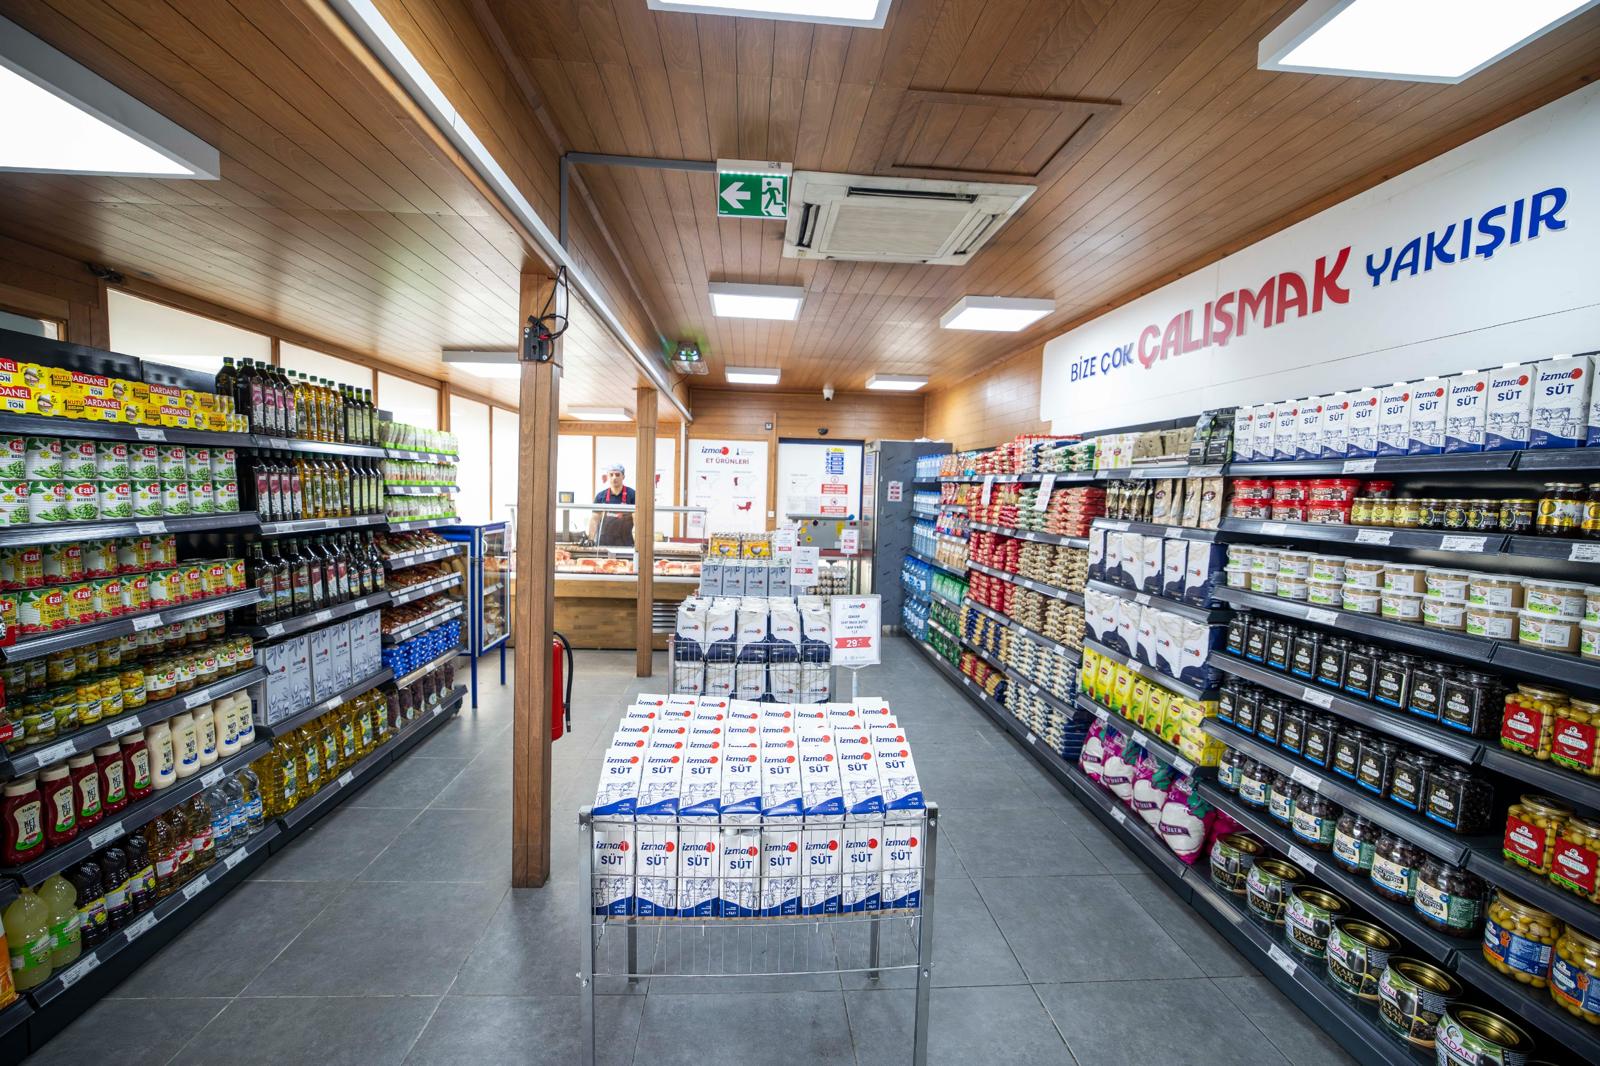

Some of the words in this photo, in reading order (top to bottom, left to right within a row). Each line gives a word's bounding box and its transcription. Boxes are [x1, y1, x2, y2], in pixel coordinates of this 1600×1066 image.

[1071, 355, 1096, 383] BİZE
[1100, 342, 1133, 375] ÇOK
[1138, 246, 1351, 370] ÇALIŞMAK
[1366, 187, 1568, 288] YAKIŞIR
[1540, 368, 1580, 381] izmar
[150, 386, 181, 397] DARDANEL
[1546, 384, 1574, 396] SÜT
[1498, 390, 1522, 402] SÜT
[8, 401, 24, 409] TON
[1456, 396, 1478, 406] SÜT
[1387, 406, 1404, 414] SÜT
[1419, 402, 1438, 410] SÜT
[161, 407, 190, 417] DARDANEL
[1356, 410, 1372, 418] SÜT
[1304, 416, 1318, 424] SÜT
[1329, 413, 1344, 421] SÜT
[715, 457, 750, 465] ÜRÜNLERİ
[78, 487, 95, 495] tat
[846, 639, 857, 648] 29
[730, 765, 752, 773] SÜT
[809, 765, 829, 773] SÜT
[886, 761, 905, 769] SÜT
[610, 766, 632, 774] SÜT
[652, 766, 673, 774] SÜT
[691, 767, 712, 775] SÜT
[770, 766, 791, 774] SÜT
[601, 854, 624, 865] SÜT
[811, 855, 832, 865] SÜT
[851, 854, 872, 863] SÜT
[891, 851, 912, 861] SÜT
[646, 856, 669, 866] SÜT
[688, 856, 710, 866] SÜT
[730, 860, 752, 869] SÜT
[770, 856, 792, 866] SÜT
[1443, 1036, 1476, 1063] ADAN
